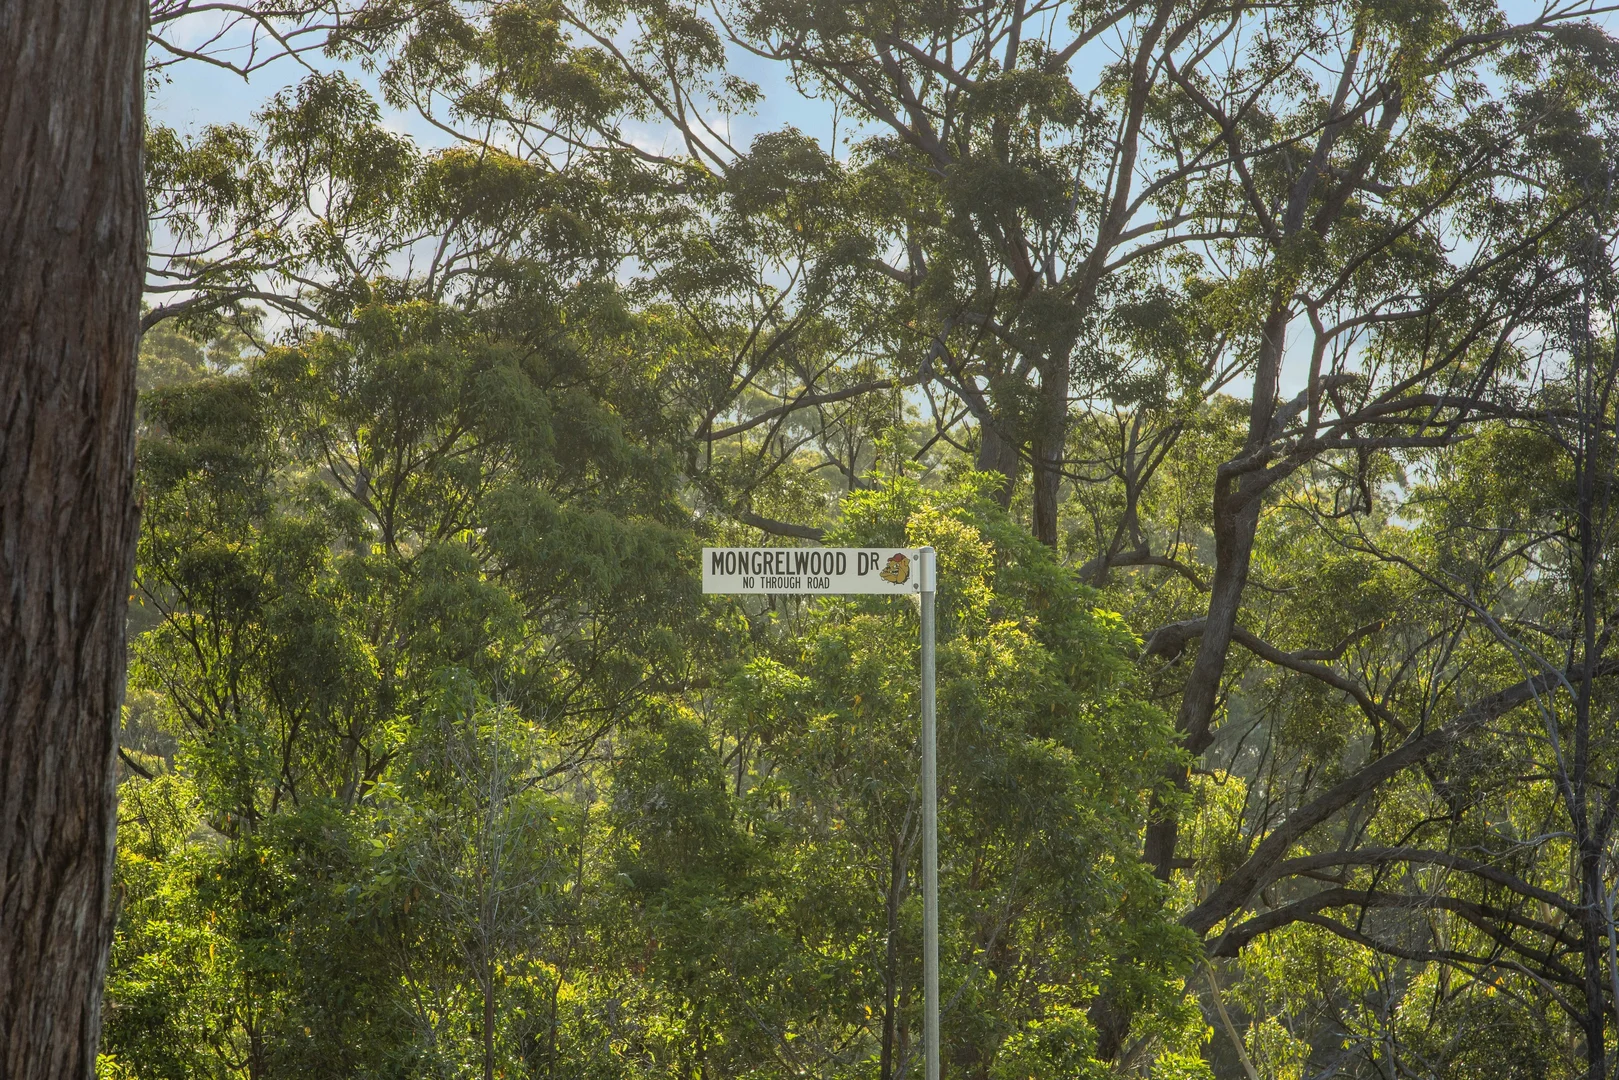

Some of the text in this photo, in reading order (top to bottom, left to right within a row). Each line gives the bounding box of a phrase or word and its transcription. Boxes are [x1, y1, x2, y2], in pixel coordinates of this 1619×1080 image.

[711, 551, 880, 576] MONGRELWOOD DR
[742, 576, 830, 589] NO THROUGH ROAD
